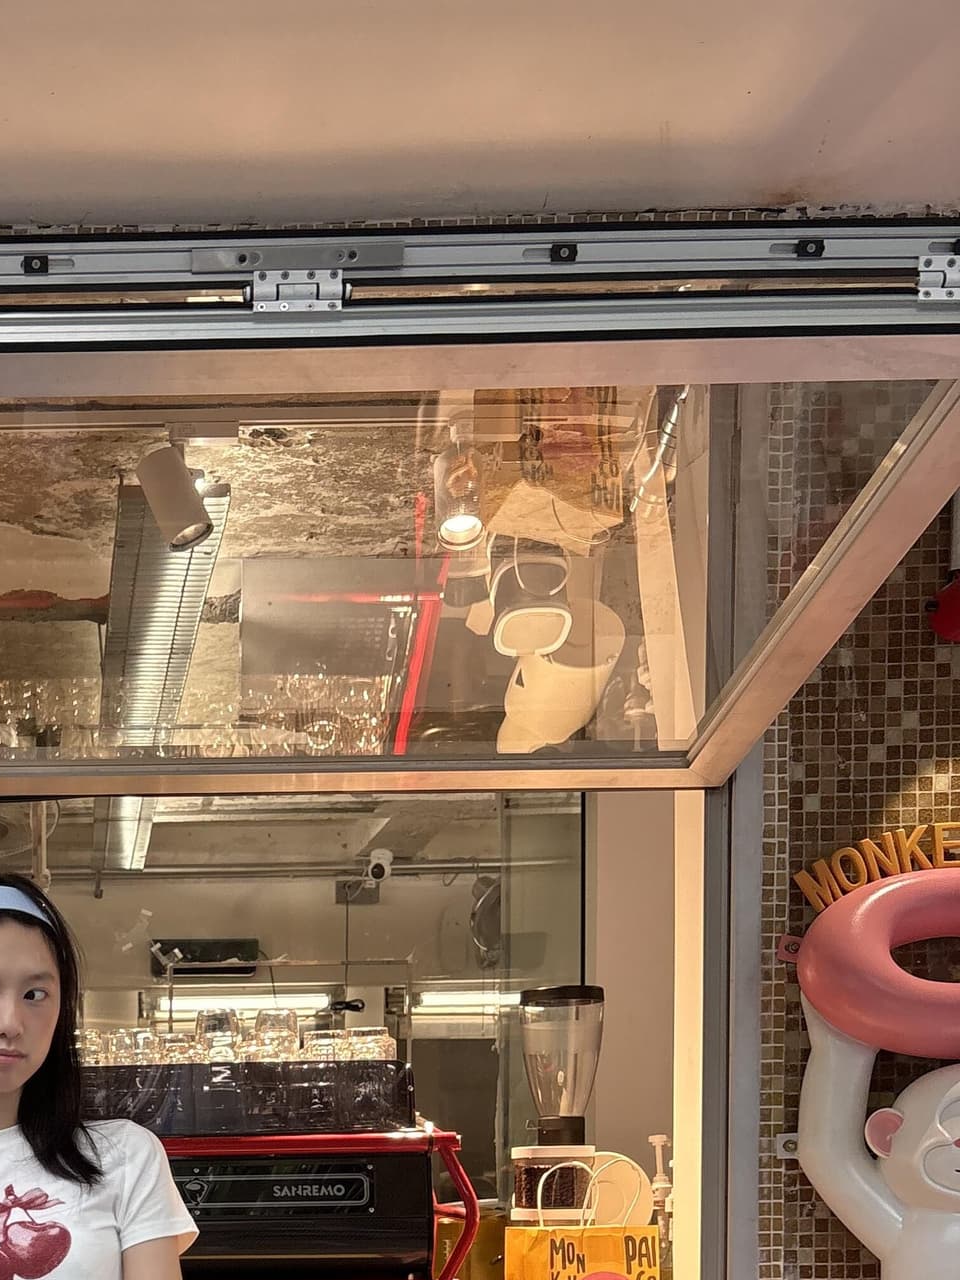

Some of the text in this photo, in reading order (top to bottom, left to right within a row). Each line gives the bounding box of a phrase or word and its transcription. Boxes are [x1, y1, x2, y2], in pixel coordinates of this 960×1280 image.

[793, 822, 960, 912] MONKE
[272, 1184, 346, 1197] SANREMO
[624, 1235, 657, 1275] PAI
